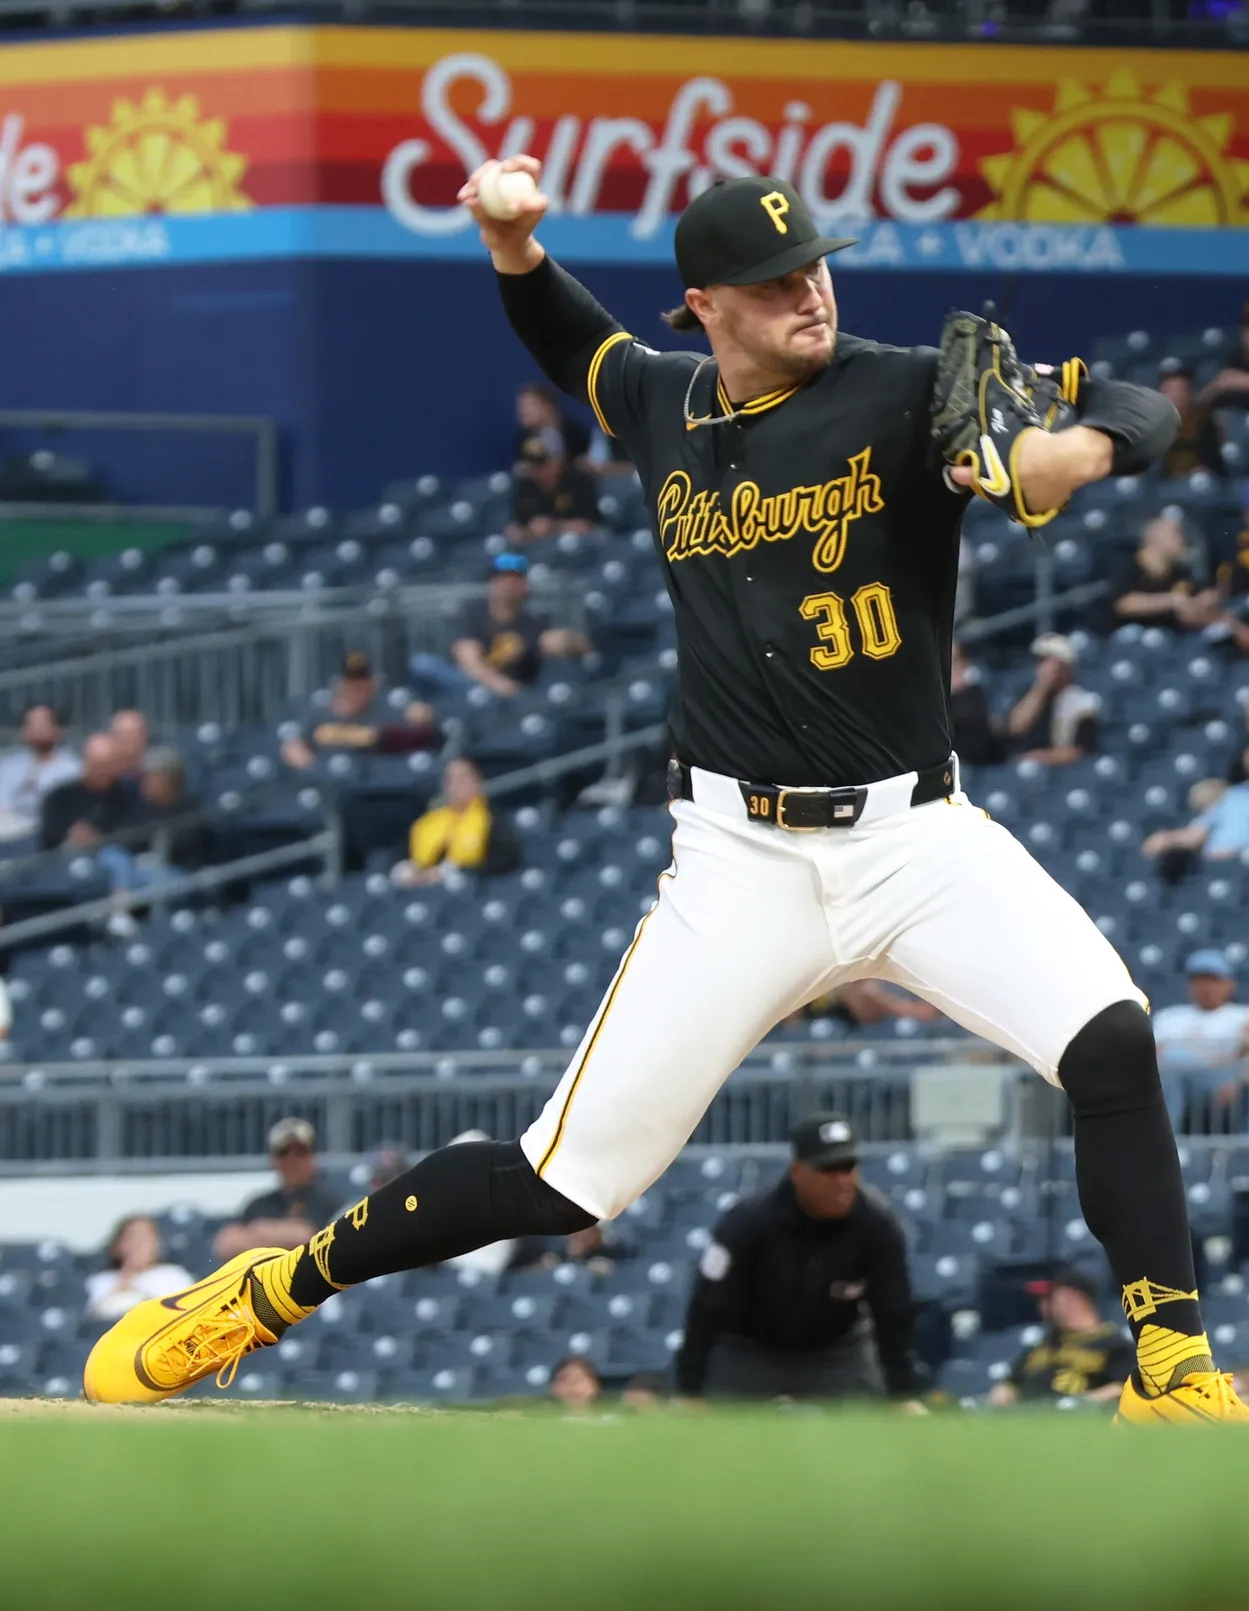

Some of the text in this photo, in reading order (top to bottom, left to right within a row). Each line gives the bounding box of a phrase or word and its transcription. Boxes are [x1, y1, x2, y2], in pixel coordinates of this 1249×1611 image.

[380, 52, 963, 240] Surfside
[760, 190, 791, 235] P
[953, 220, 1126, 272] VODKA
[657, 445, 885, 573] Pittsburgh
[798, 581, 902, 671] 30
[749, 795, 770, 817] 30
[344, 1196, 369, 1231] P
